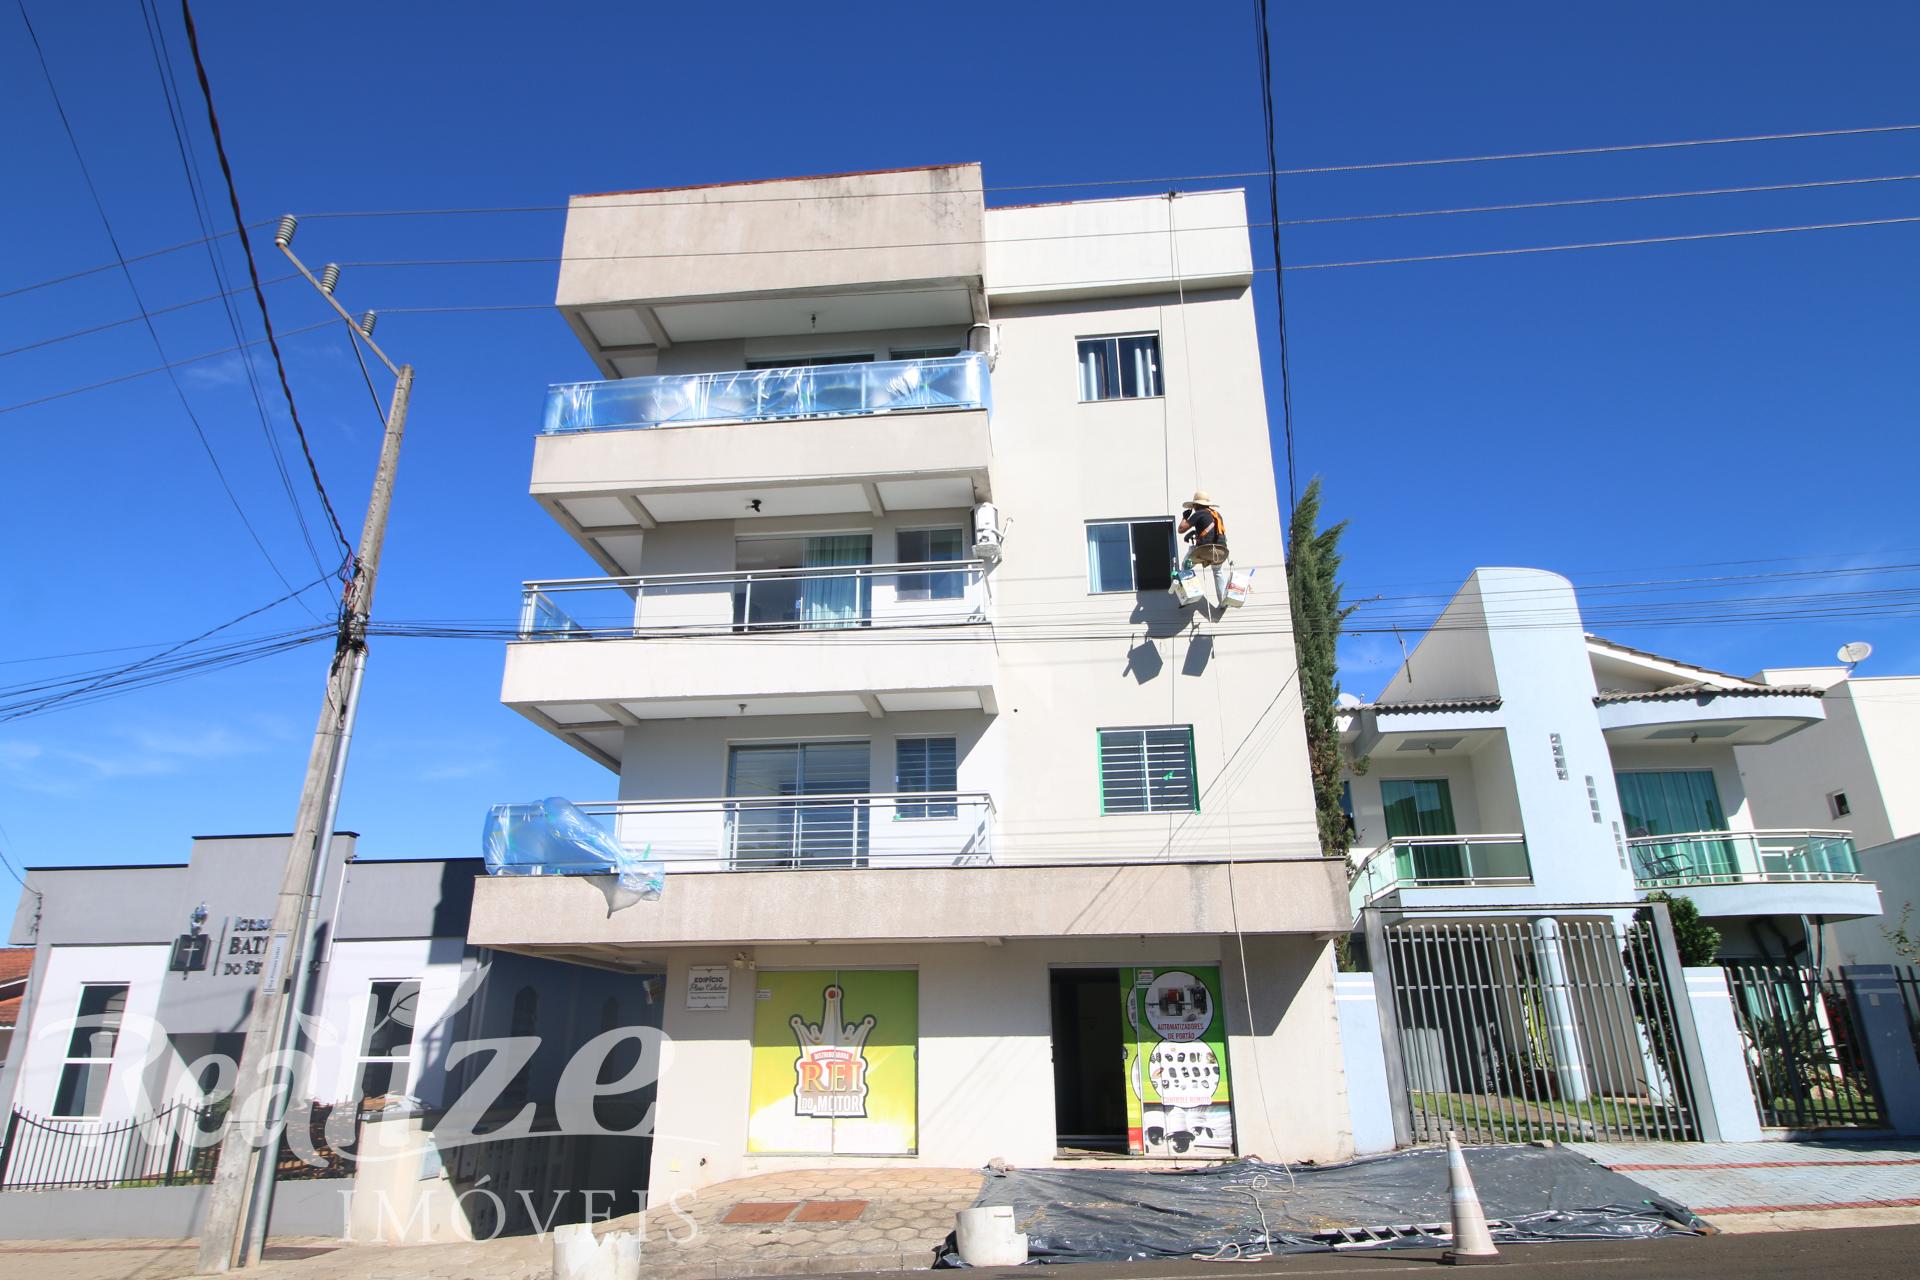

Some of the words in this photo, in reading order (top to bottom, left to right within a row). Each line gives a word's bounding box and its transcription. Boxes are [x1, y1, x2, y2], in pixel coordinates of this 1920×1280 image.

[803, 1064, 861, 1092] REI
[801, 1097, 814, 1110] DO
[817, 1095, 861, 1112] MOTOR
